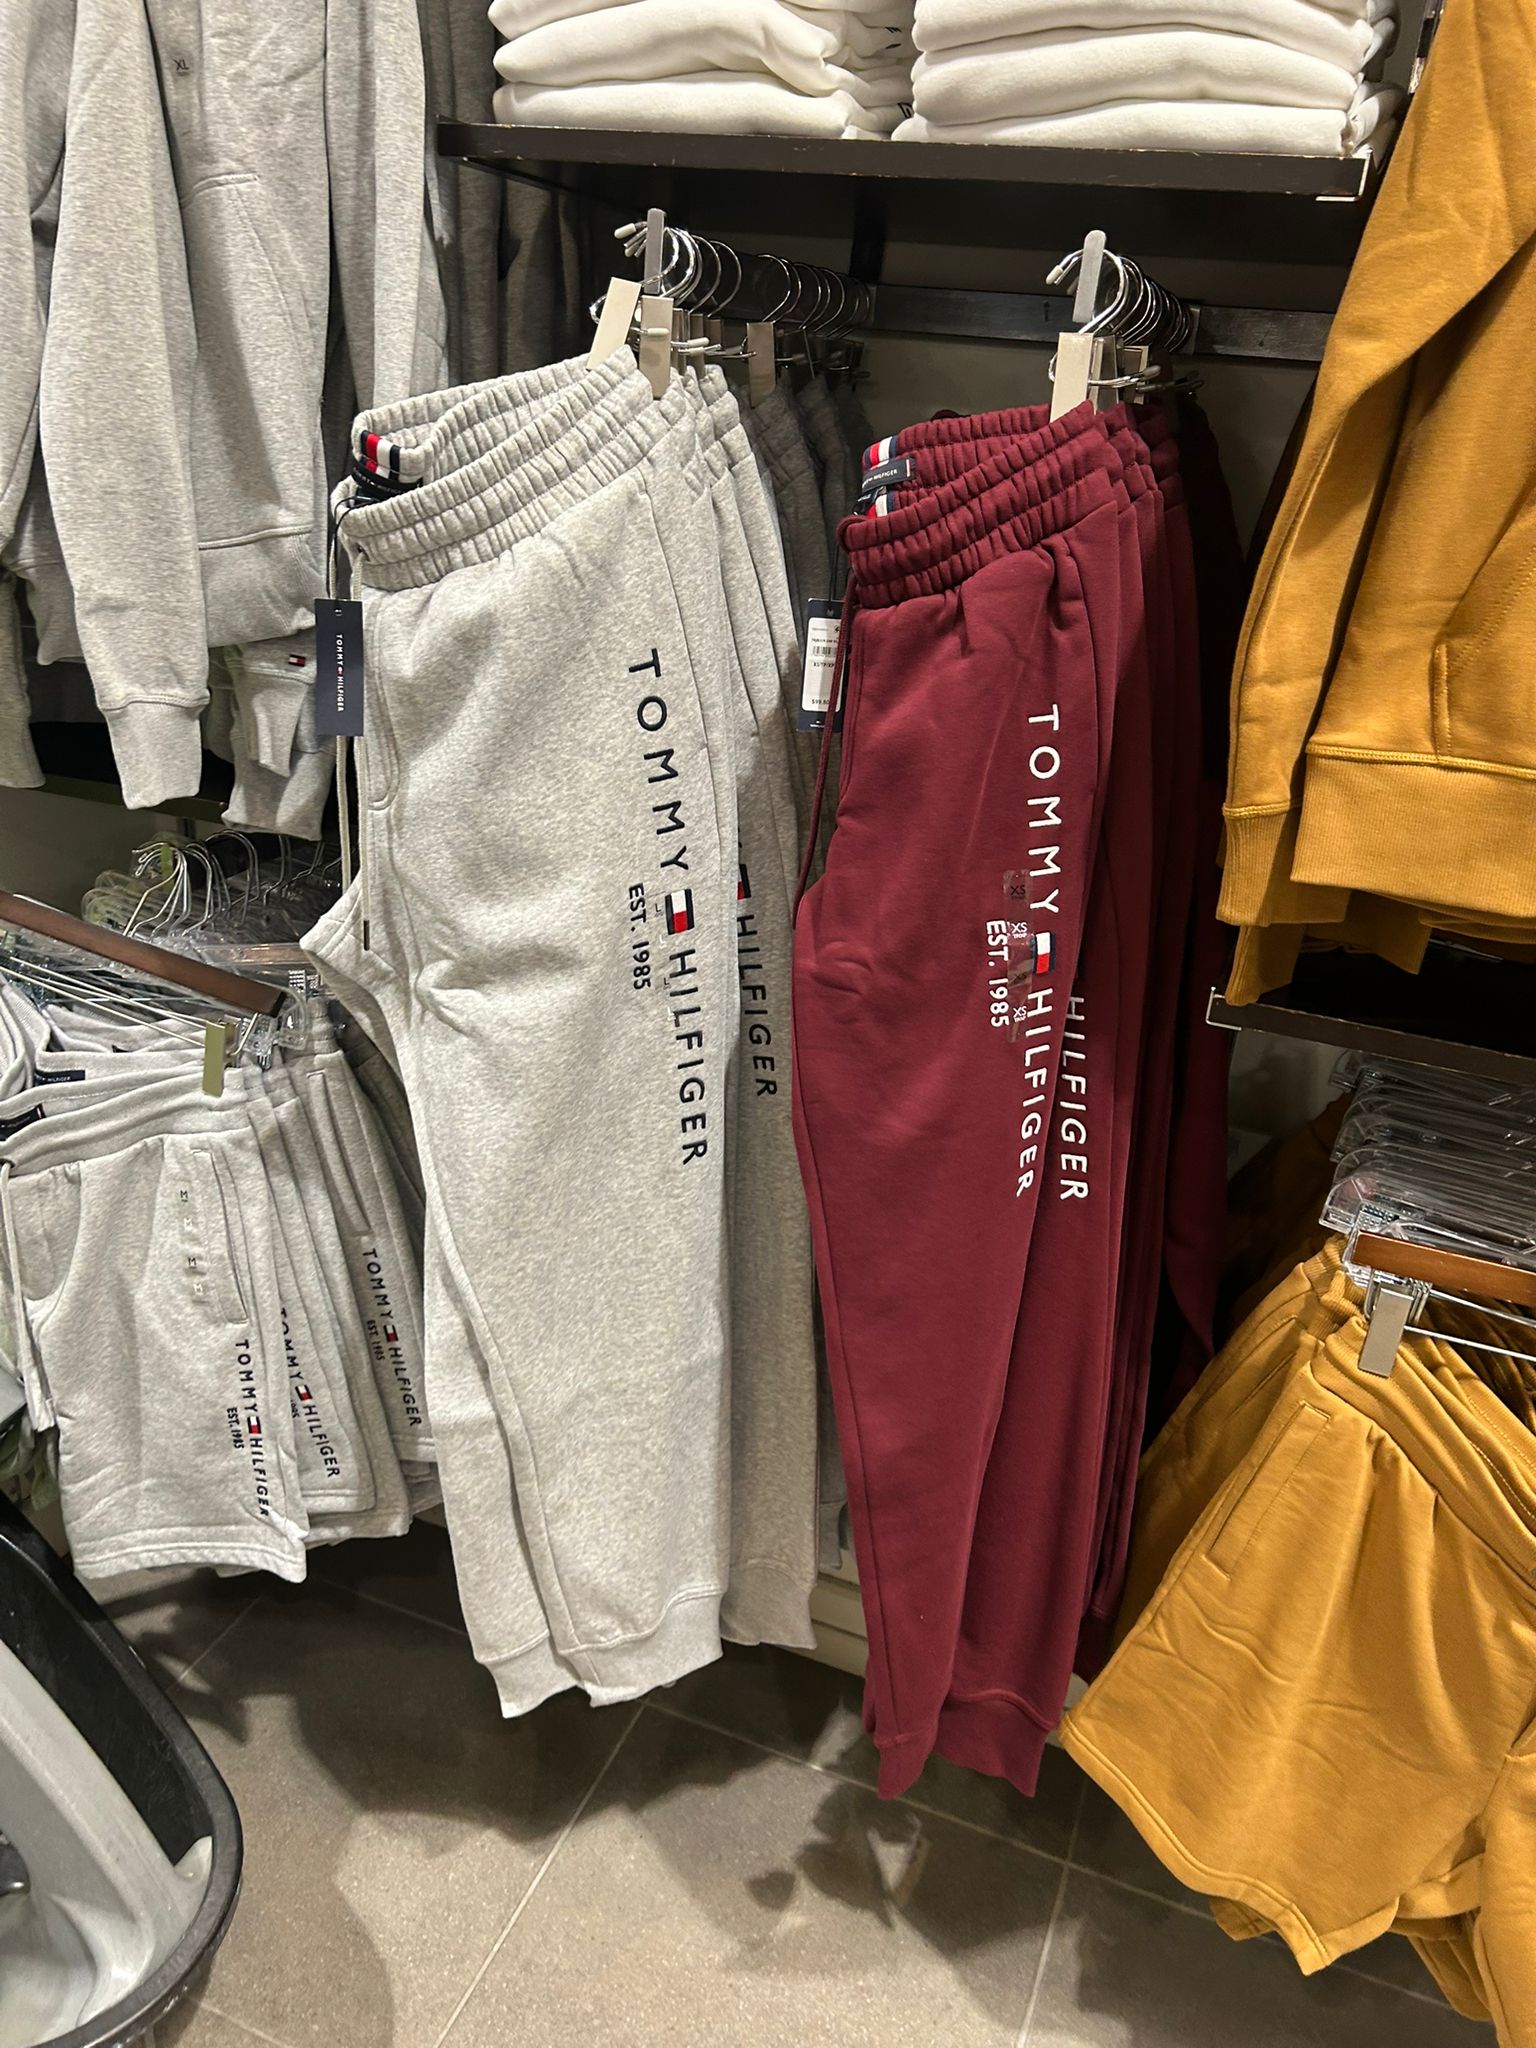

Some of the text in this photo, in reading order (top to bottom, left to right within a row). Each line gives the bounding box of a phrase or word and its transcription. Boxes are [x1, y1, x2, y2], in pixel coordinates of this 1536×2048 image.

[172, 59, 189, 70] XL
[335, 634, 345, 712] TOMMY HILFIGER
[629, 648, 708, 1165] TOMMY HILFIGER
[1010, 885, 1026, 895] XS
[1011, 921, 1028, 934] XS
[629, 882, 652, 989] EST. 1985
[1016, 703, 1062, 1198] TOMMY HILFIGER
[736, 915, 778, 1097] HILFIGER
[986, 920, 1010, 1028] EST. 1985
[1013, 1005, 1027, 1018] XS
[1059, 996, 1089, 1200] HILFIGER
[180, 1190, 188, 1199] M
[188, 1257, 197, 1265] M
[363, 1248, 422, 1427] TOMMY HILFIGER
[372, 1341, 386, 1361] 1985
[227, 1407, 245, 1450] EST. 1985
[235, 1339, 269, 1516] TOMMY HILFIGER
[303, 1405, 340, 1478] HILFIGER
